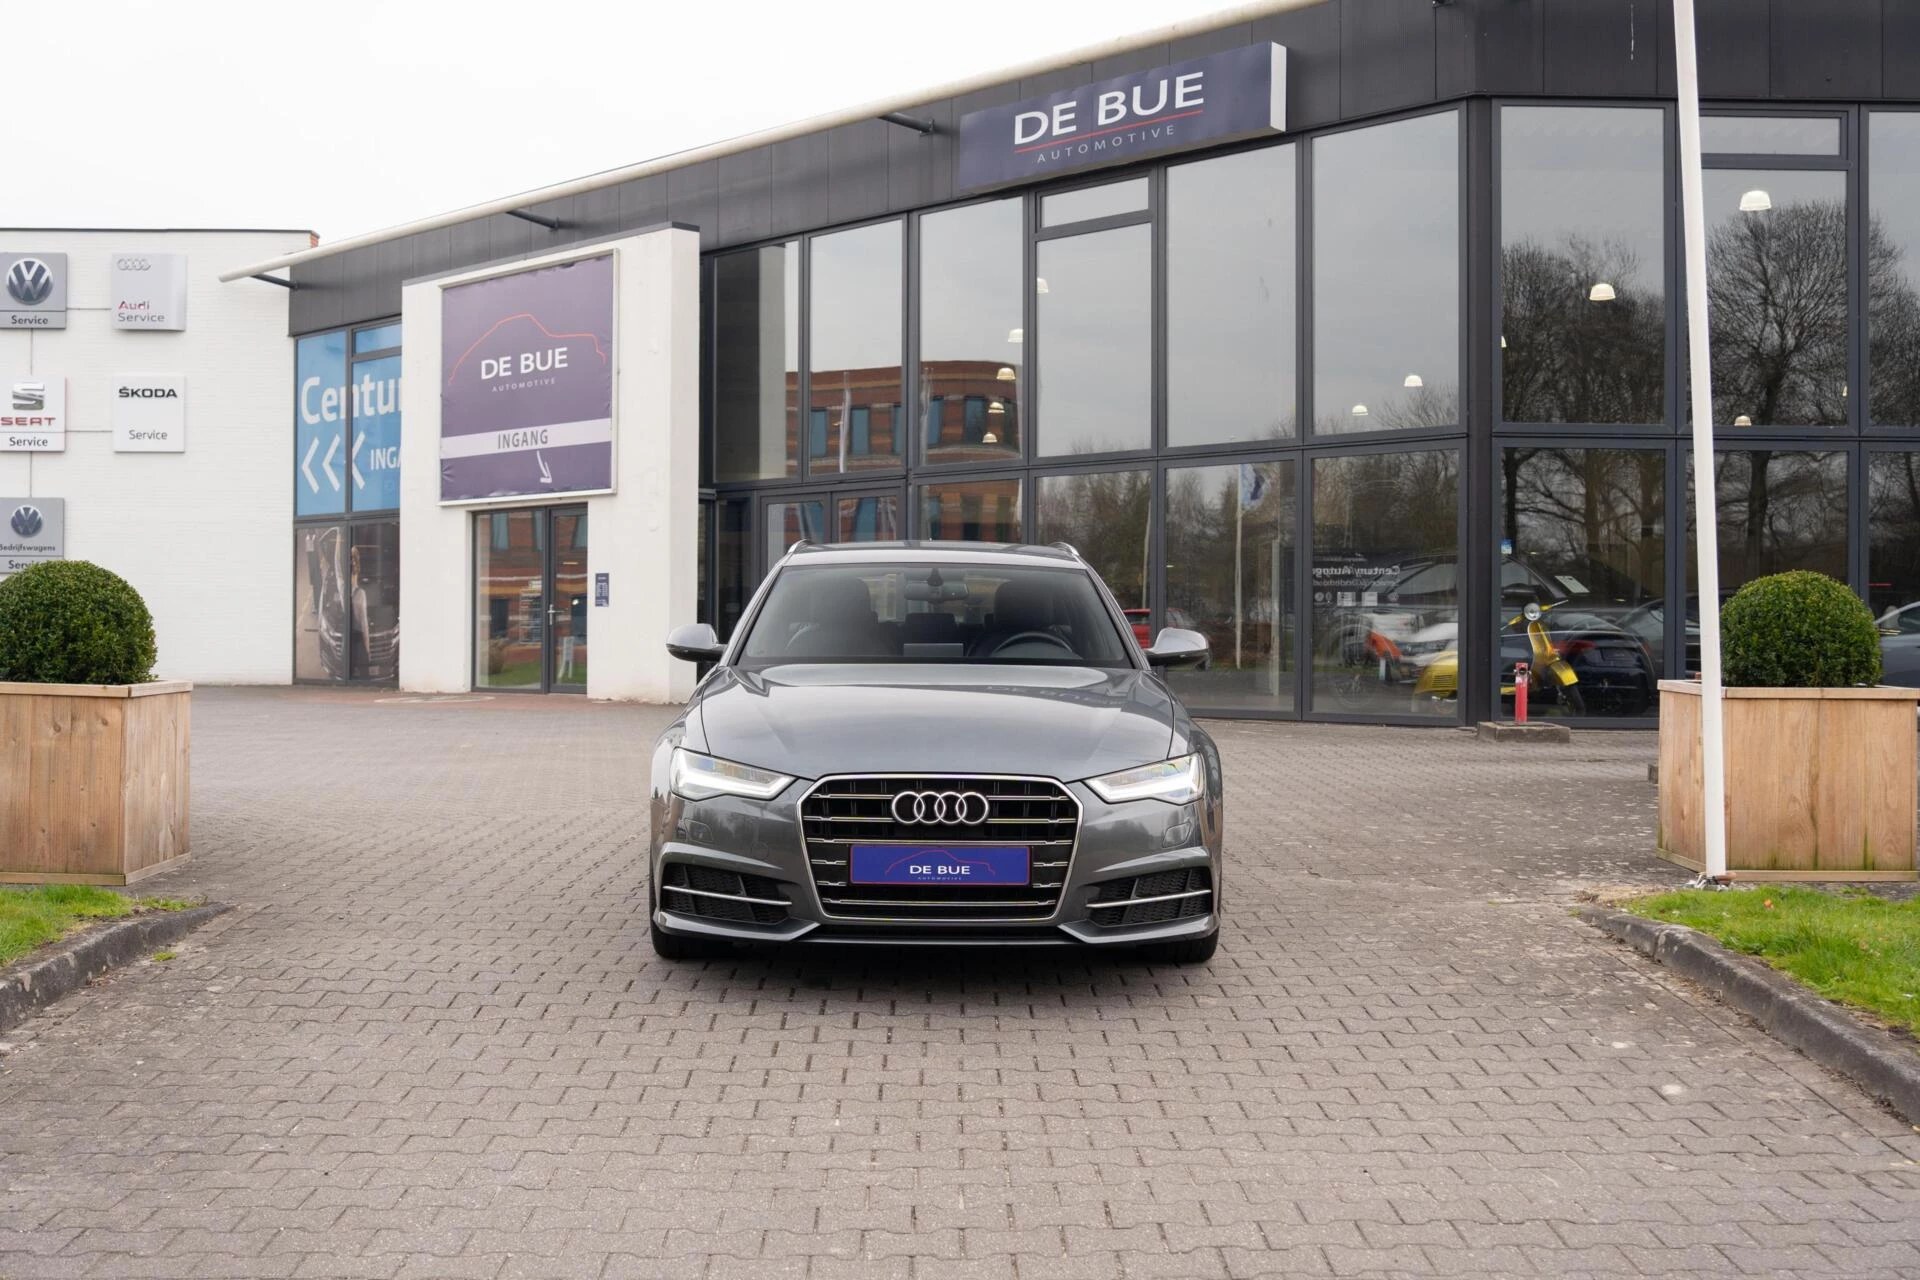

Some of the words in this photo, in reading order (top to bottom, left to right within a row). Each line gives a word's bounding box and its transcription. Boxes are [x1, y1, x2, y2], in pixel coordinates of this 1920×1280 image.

[1014, 101, 1077, 145] DE
[1098, 71, 1204, 126] BUE
[1037, 124, 1176, 163] AUTOMOTIVE
[118, 300, 151, 310] Audi
[11, 314, 49, 325] Service
[117, 313, 165, 323] Service
[481, 355, 512, 380] DE
[520, 347, 569, 374] BUE
[492, 377, 556, 392] AUTOMOTIVE
[118, 386, 178, 399] ŠKODA
[0, 416, 56, 426] SEAT
[128, 430, 168, 440] Service
[497, 429, 549, 450] INGANG
[9, 437, 48, 447] Service
[909, 865, 932, 875] DE
[937, 865, 971, 875] BUE
